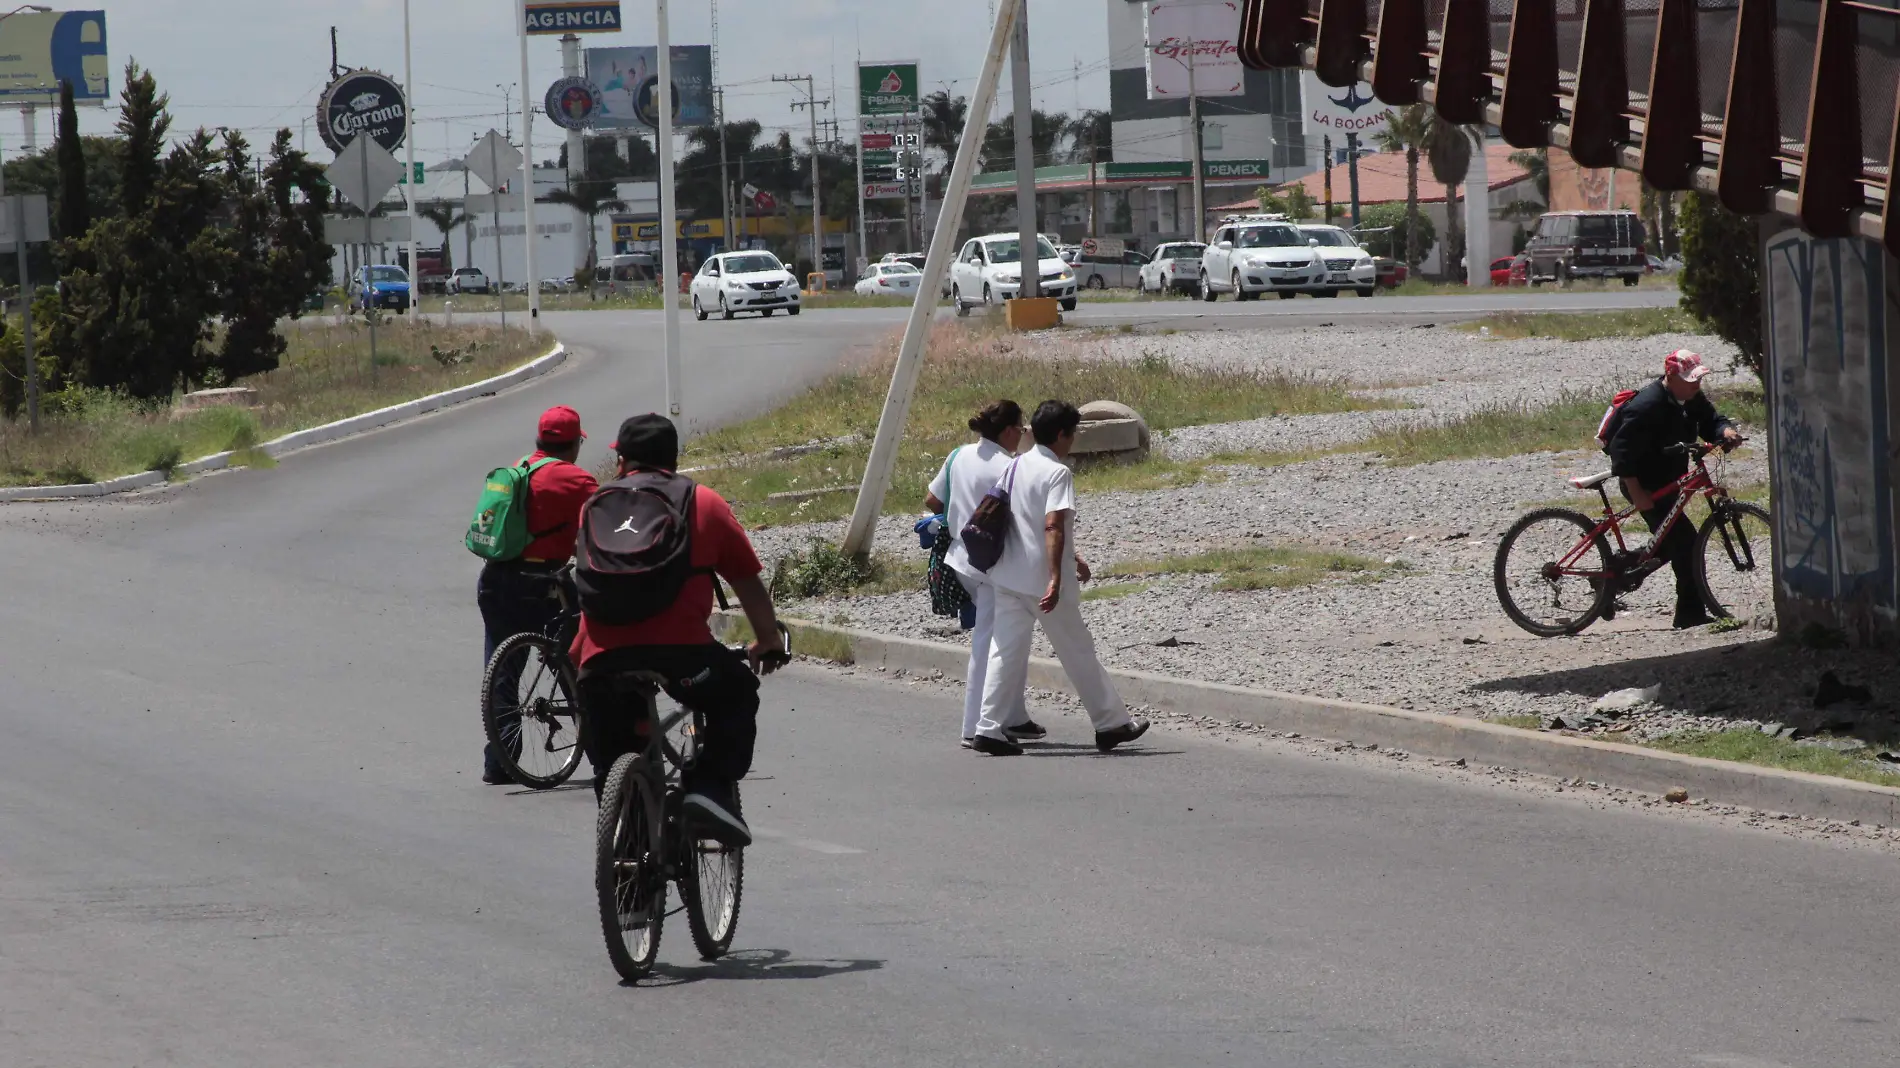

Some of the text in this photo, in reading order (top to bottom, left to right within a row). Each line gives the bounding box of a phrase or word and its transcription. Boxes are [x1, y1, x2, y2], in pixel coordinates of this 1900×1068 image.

[526, 9, 616, 28] AGENCIA
[868, 95, 911, 105] PEMEX
[333, 104, 404, 135] Corona
[1312, 110, 1329, 126] LA
[1209, 164, 1260, 176] PEMEX
